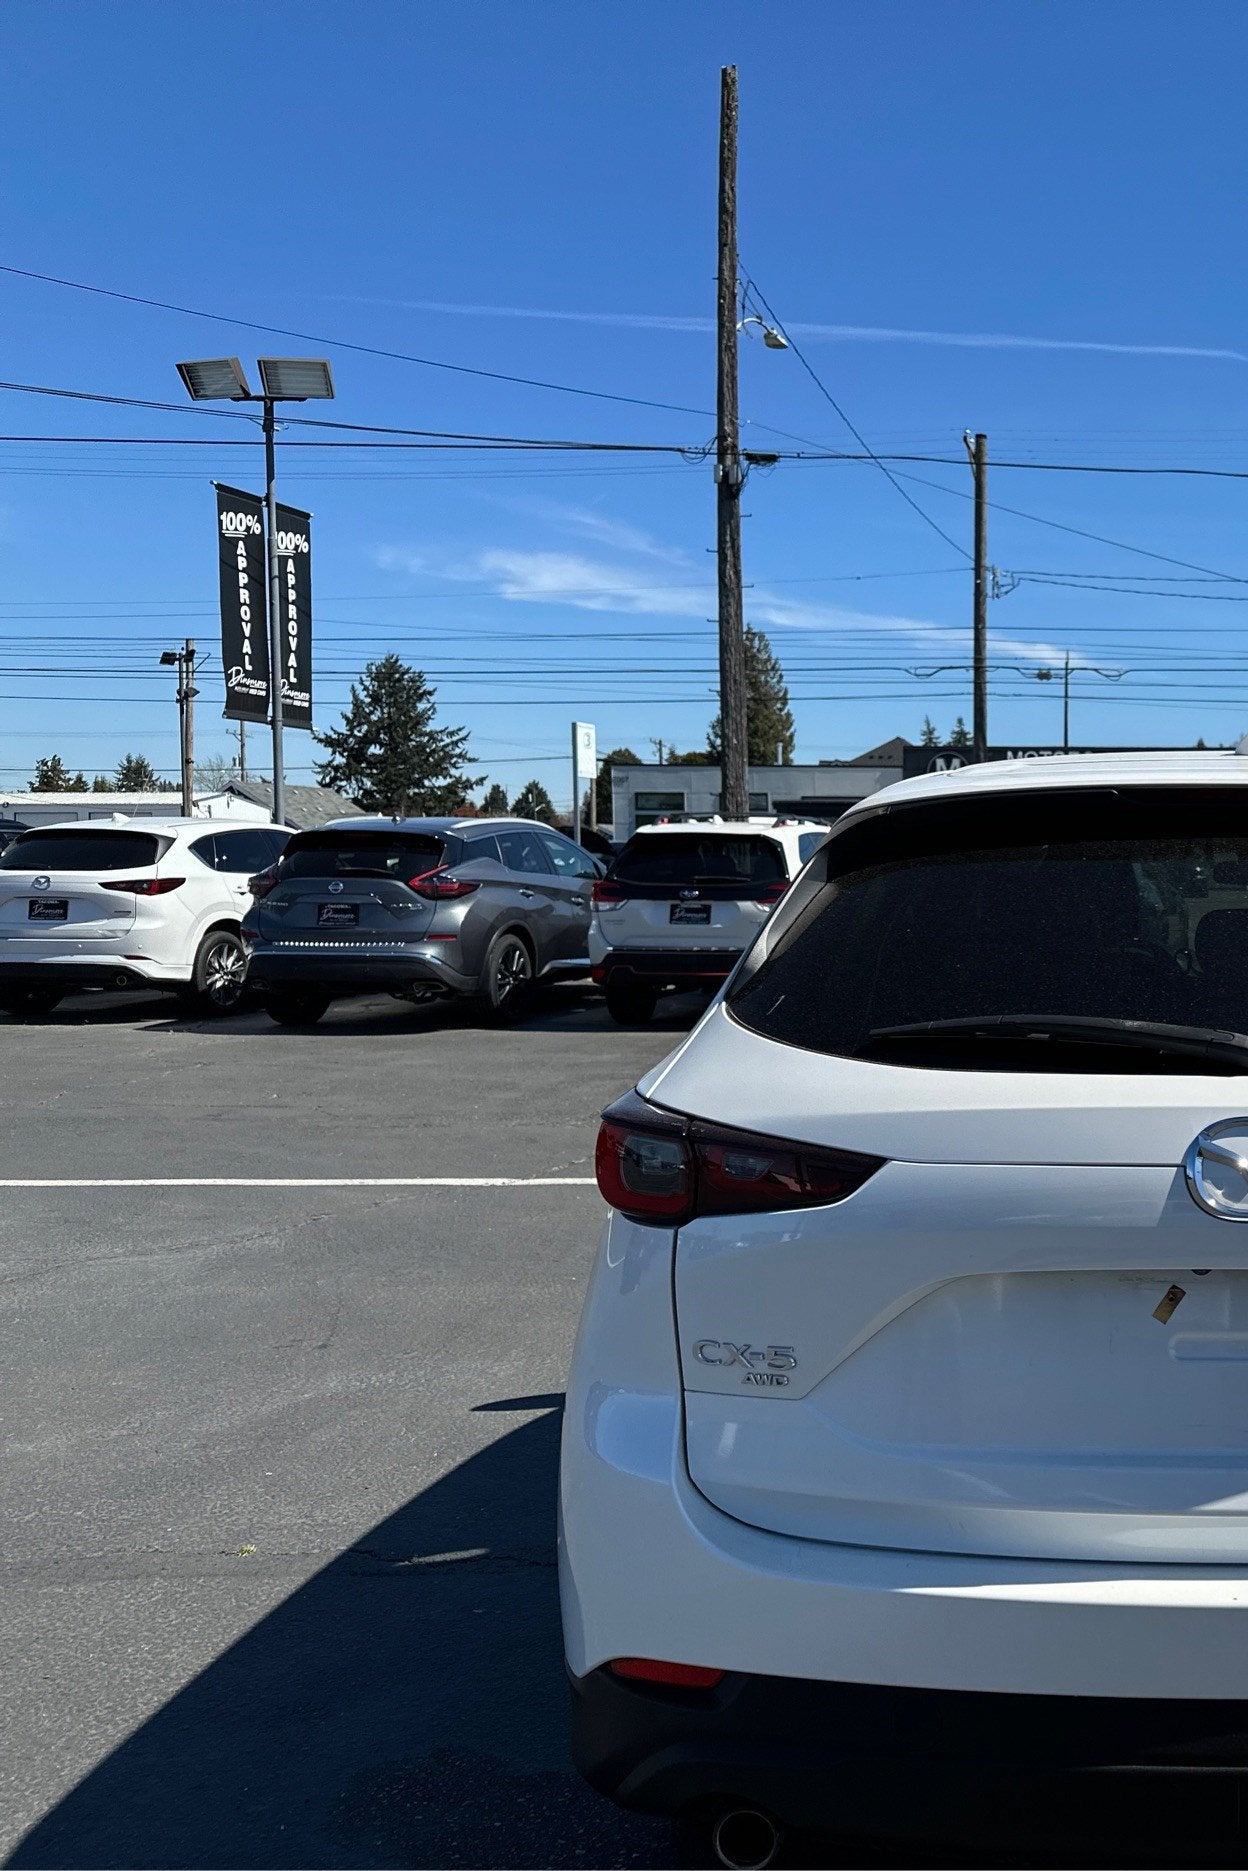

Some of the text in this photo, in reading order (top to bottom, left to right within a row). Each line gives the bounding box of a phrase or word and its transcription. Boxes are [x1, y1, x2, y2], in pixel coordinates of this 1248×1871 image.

[220, 511, 261, 535] 100%
[277, 531, 309, 554] 00%
[236, 540, 253, 671] APPROVAL
[286, 558, 298, 683] APPROVAL
[693, 1339, 797, 1371] CX-5
[741, 1372, 790, 1387] AWD
